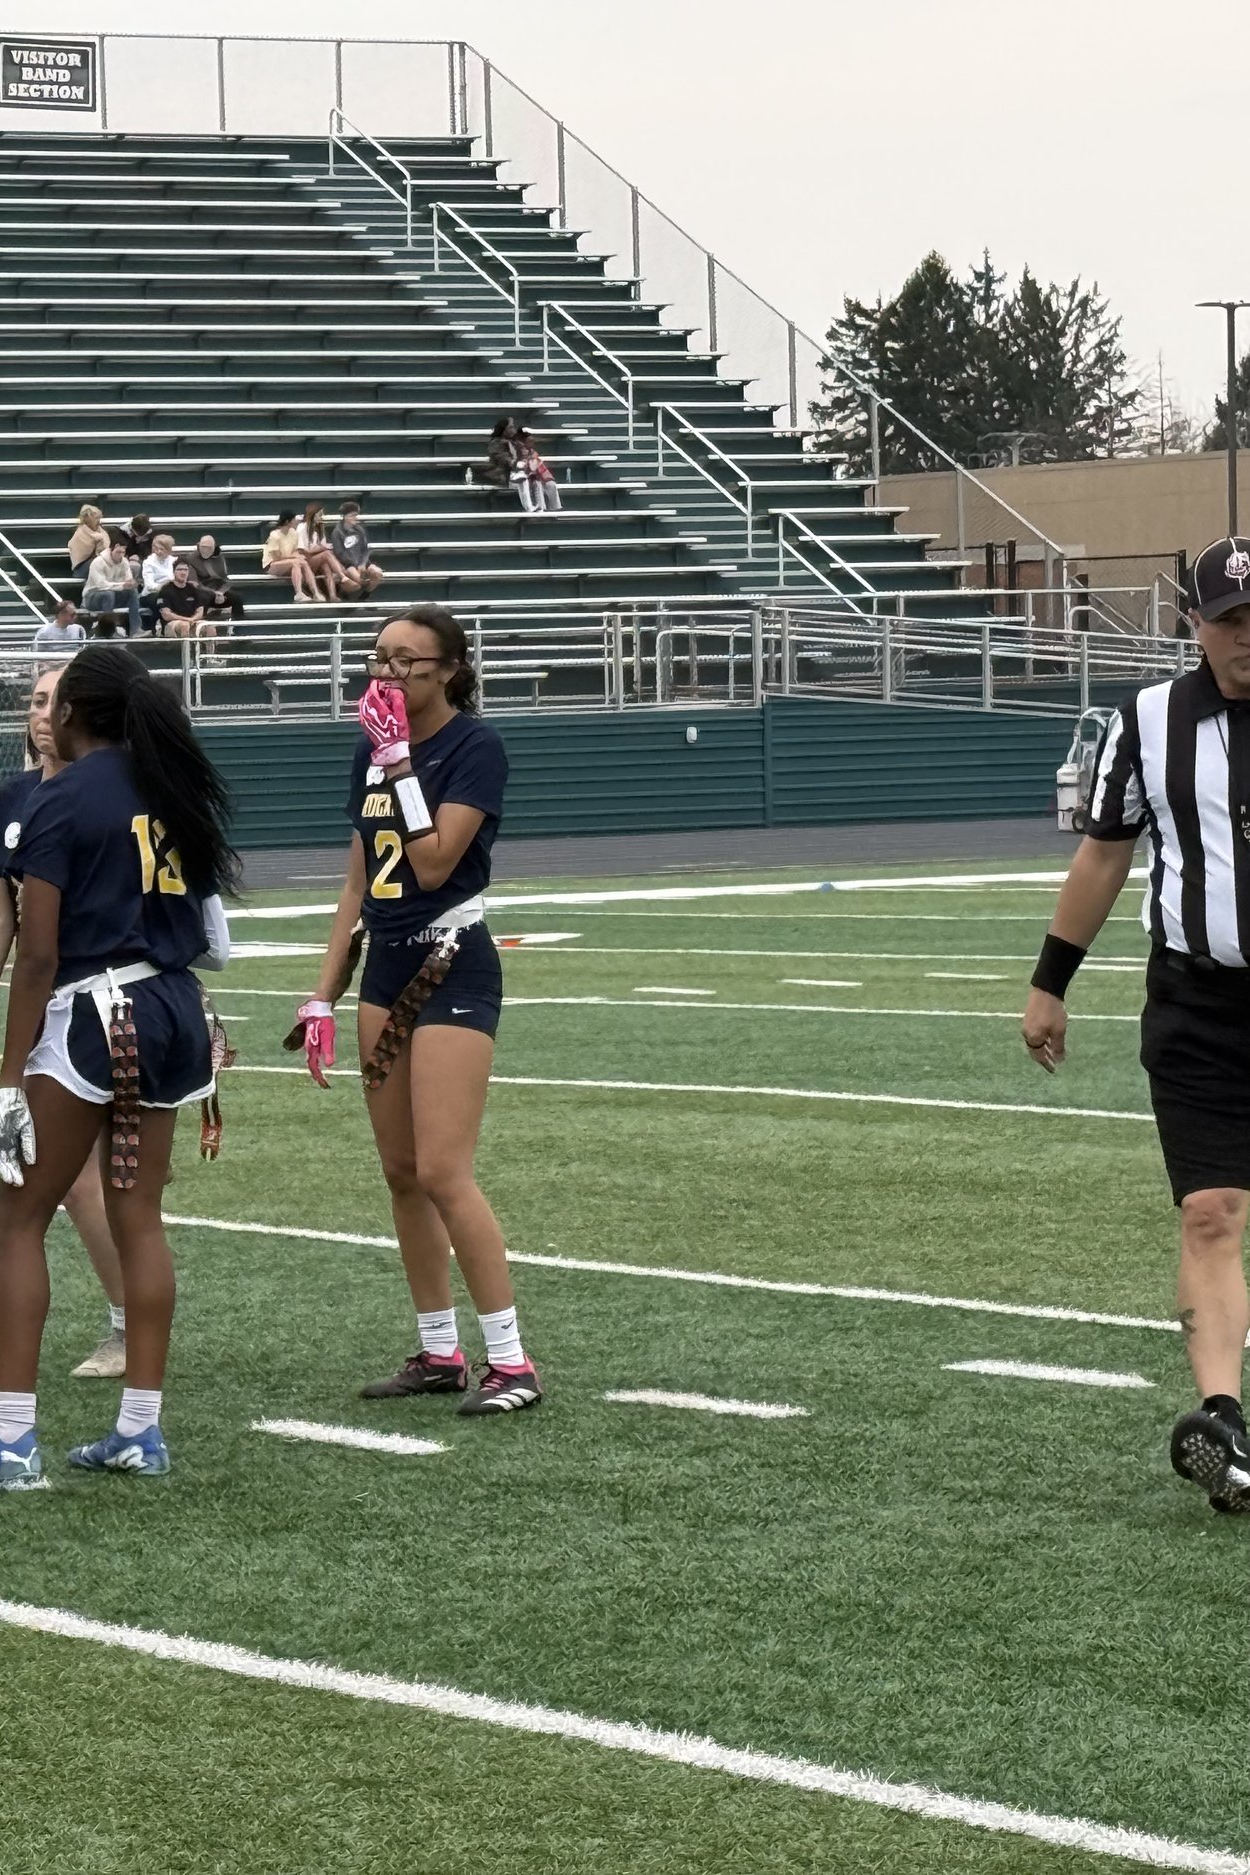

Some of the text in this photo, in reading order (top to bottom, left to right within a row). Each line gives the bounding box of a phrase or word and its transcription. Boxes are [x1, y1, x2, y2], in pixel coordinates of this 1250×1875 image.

[10, 50, 82, 68] VISITOR
[21, 67, 71, 83] BAND
[7, 83, 85, 100] SECTION
[371, 830, 403, 899] 2
